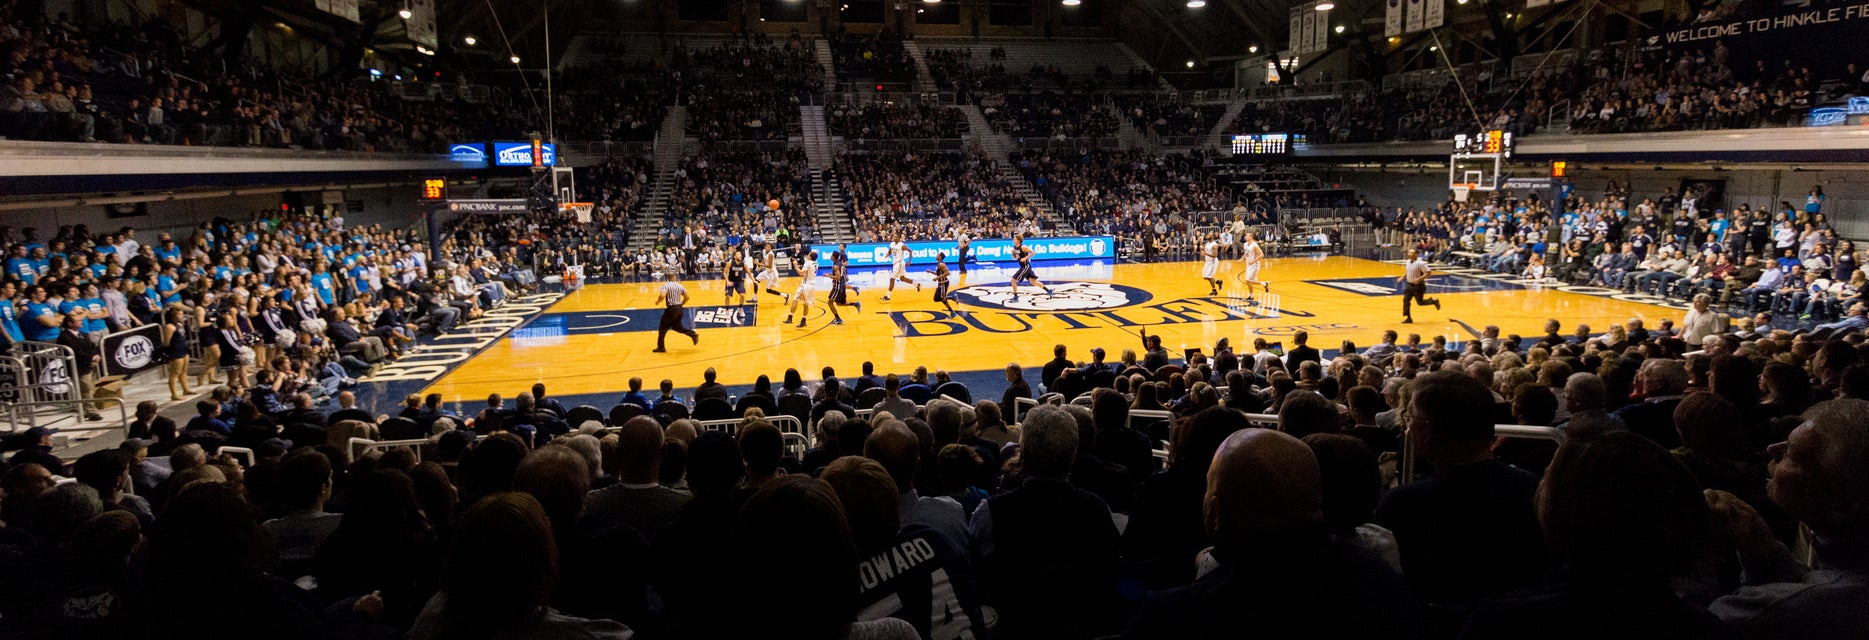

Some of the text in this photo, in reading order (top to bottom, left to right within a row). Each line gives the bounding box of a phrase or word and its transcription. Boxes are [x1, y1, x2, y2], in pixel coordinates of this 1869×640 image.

[1666, 22, 1742, 43] WELCOME
[1747, 19, 1769, 33] TO
[1774, 8, 1840, 29] HINKLE
[903, 248, 927, 257] Poud
[1035, 244, 1046, 254] Go
[877, 296, 1315, 338] BUTLER
[124, 341, 146, 358] FOX
[859, 537, 935, 594] OWARD
